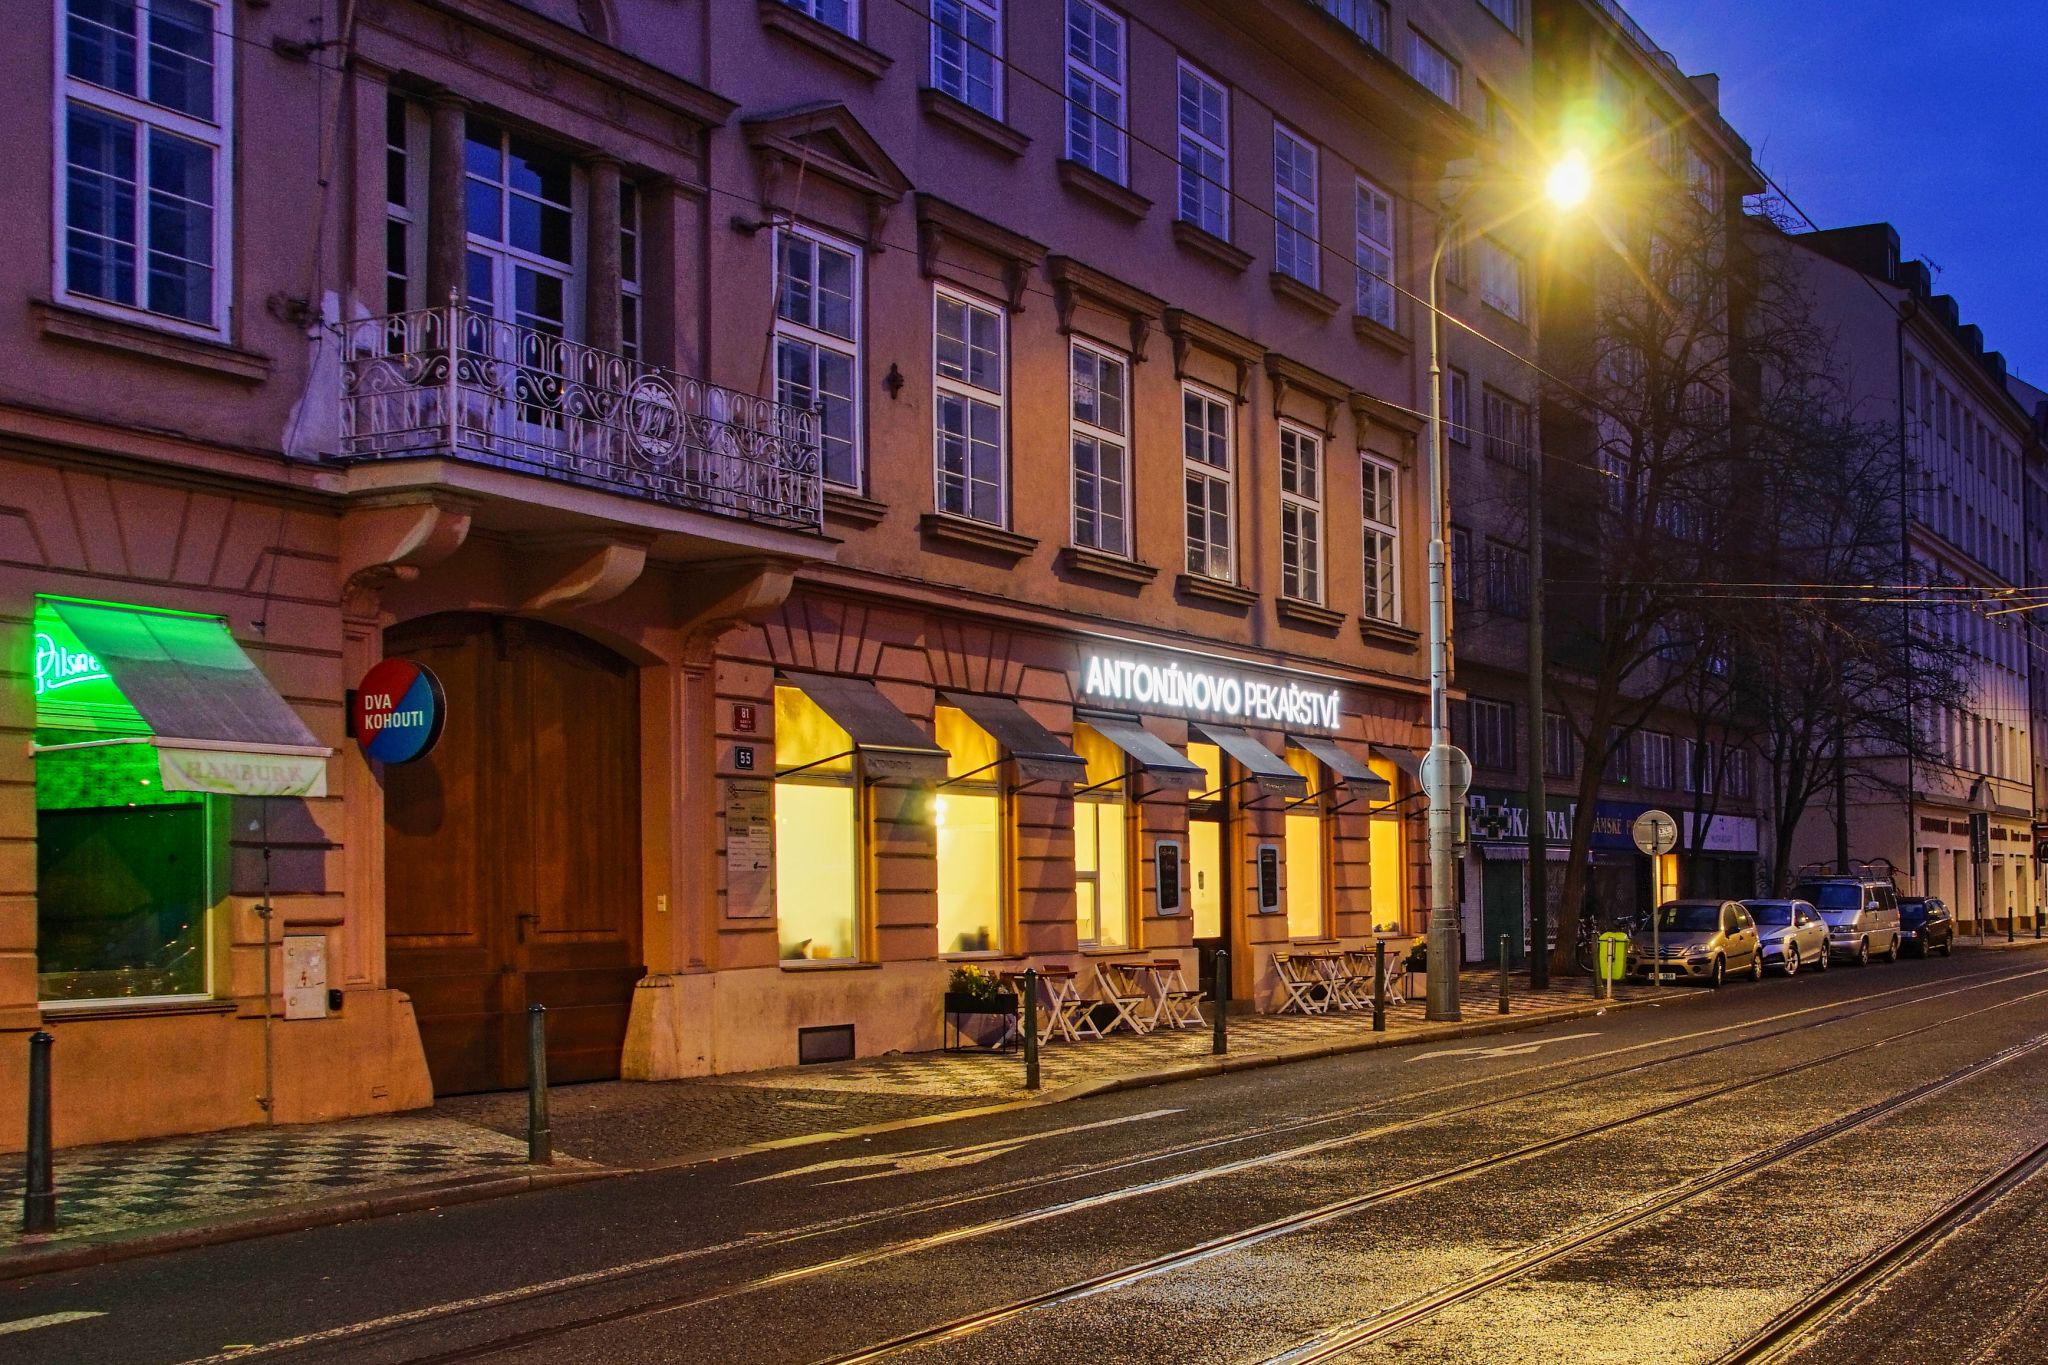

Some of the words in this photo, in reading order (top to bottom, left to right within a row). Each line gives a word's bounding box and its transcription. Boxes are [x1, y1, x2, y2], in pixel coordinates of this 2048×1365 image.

[1086, 656, 1241, 715] ANTONÍNOVO
[1244, 681, 1340, 729] PEKAŘSTVÍ
[365, 694, 392, 710] DVA
[365, 711, 423, 730] KOHOUTI
[741, 708, 750, 719] 81
[740, 752, 751, 764] 55
